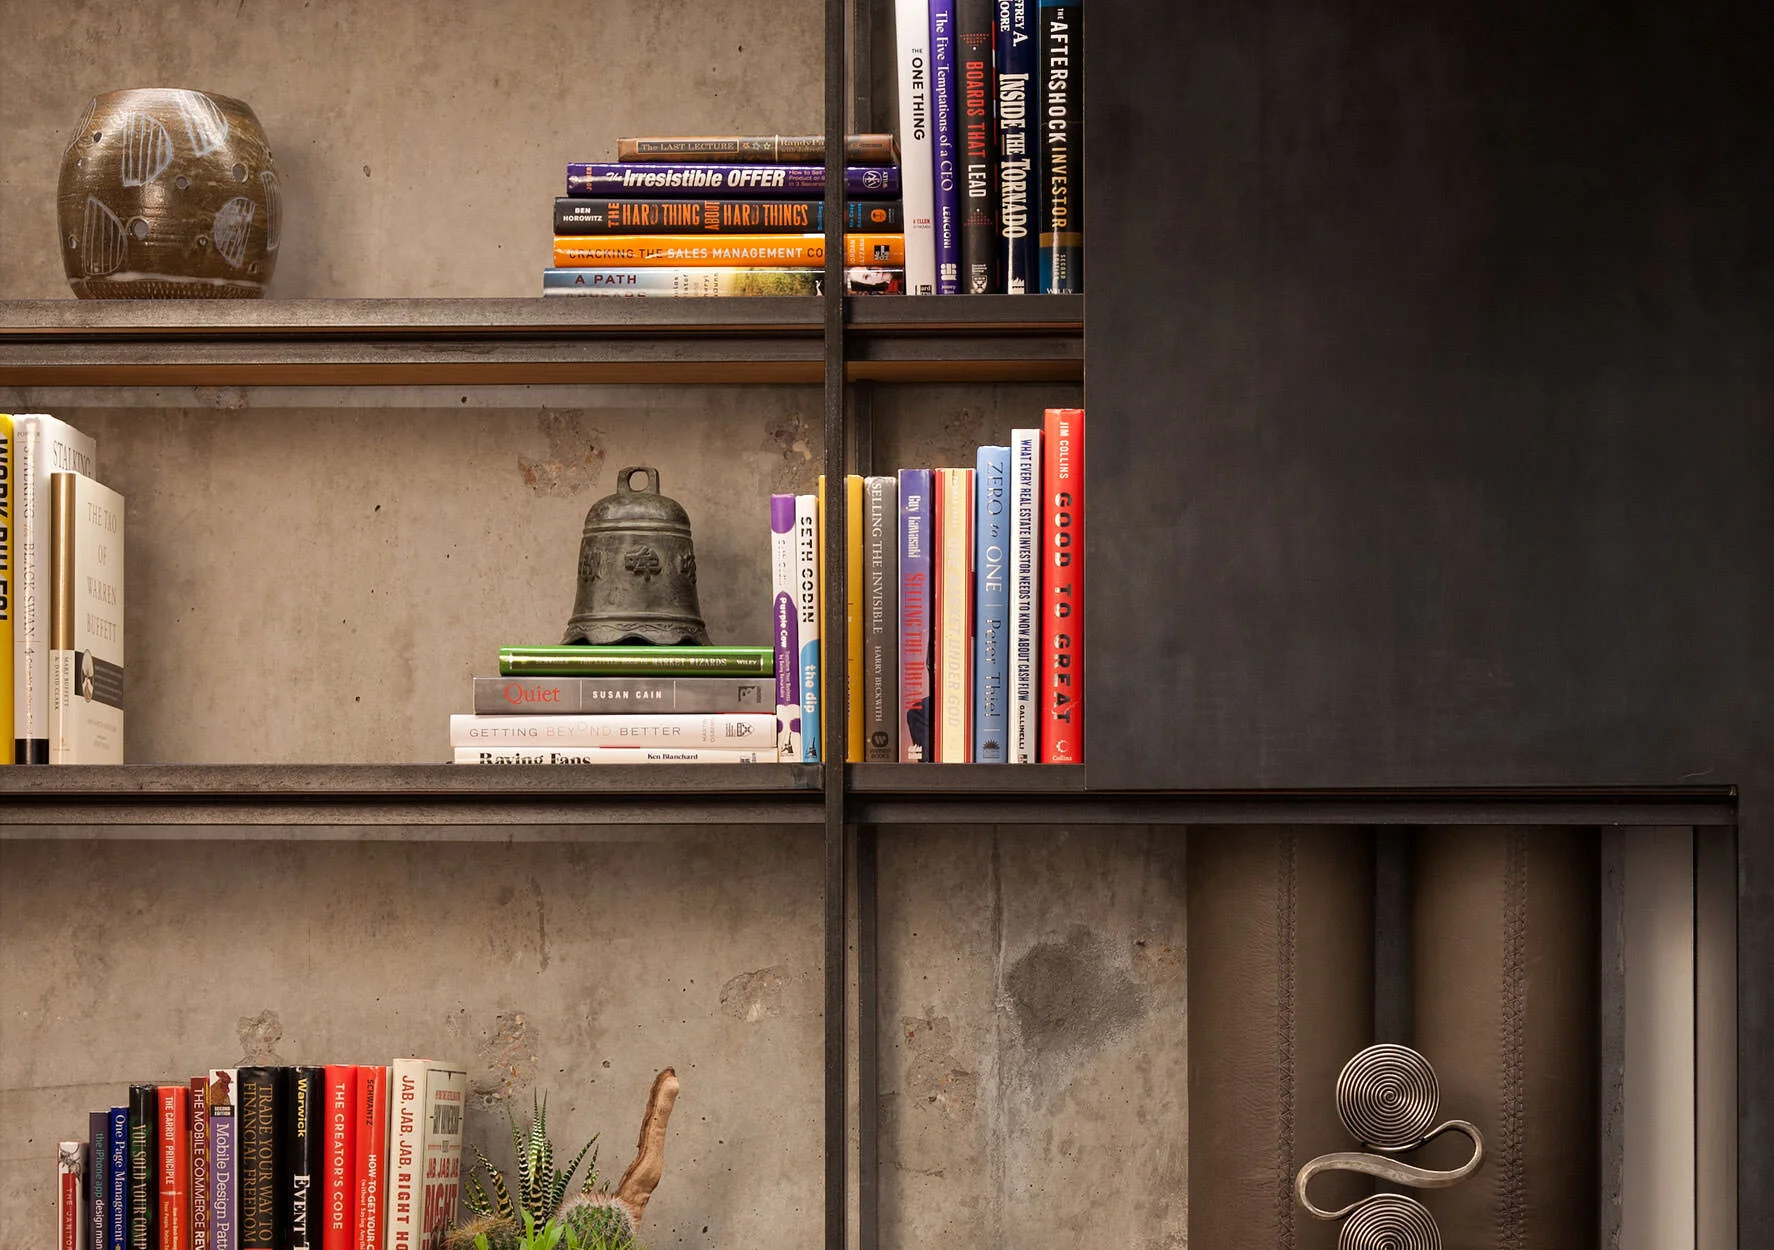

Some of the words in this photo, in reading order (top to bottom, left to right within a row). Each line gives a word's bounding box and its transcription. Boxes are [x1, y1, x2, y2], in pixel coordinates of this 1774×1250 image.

[912, 57, 924, 90] ONE
[966, 62, 984, 116] BOARDS
[1048, 22, 1068, 144] AFTERSHOCK
[913, 93, 925, 140] THING
[999, 73, 1029, 130] INSIDE
[968, 122, 986, 158] THAT
[1006, 132, 1026, 155] THE
[606, 172, 624, 182] The
[623, 170, 722, 187] Irresistible
[727, 170, 786, 187] OFFER
[968, 164, 987, 197] LEAD
[1052, 147, 1068, 228] INVESTOR
[608, 202, 620, 228] THE
[622, 204, 658, 225] HARD
[662, 204, 700, 225] THING
[704, 200, 720, 230] ABOUT
[723, 204, 760, 226] HARD
[762, 204, 809, 226] THINGS
[1000, 158, 1031, 238] TORNADO
[942, 206, 951, 248] LENCIONI
[569, 248, 634, 259] CRACKING
[639, 248, 663, 259] THE
[668, 248, 708, 258] SALES
[712, 248, 803, 258] MANAGEMENT
[575, 274, 585, 284] A
[594, 274, 637, 284] PATH
[1060, 422, 1069, 437] JIM
[1060, 440, 1069, 479] COLLINS
[986, 462, 1003, 516] ZERO
[872, 482, 882, 537] SELLING
[1054, 492, 1072, 567] GOOD
[872, 540, 882, 568] THE
[986, 545, 1002, 592] ONE
[873, 572, 883, 634] INVISIBLE
[1054, 584, 1072, 618] TO
[504, 682, 560, 704] Quiet
[804, 664, 816, 688] the
[1052, 634, 1071, 724] GREAT
[592, 691, 629, 699] SUSAN
[635, 691, 662, 699] CAIN
[804, 692, 816, 713] dip
[469, 728, 538, 737] GETTING
[546, 721, 612, 737] BEYOND
[620, 727, 681, 736] BETTER
[165, 1097, 174, 1109] THE
[194, 1088, 204, 1110] THE
[335, 1083, 345, 1109] THE
[366, 1079, 374, 1126] SCHWANTZ
[402, 1076, 414, 1104] JAB,
[242, 1082, 257, 1165] FINANCIAL
[258, 1084, 273, 1135] TRADE
[297, 1078, 307, 1138] Warwick
[400, 1108, 414, 1136] JAB,
[115, 1114, 126, 1138] One
[132, 1124, 147, 1150] YOU
[165, 1111, 174, 1142] CARROT
[194, 1112, 205, 1154] MOBILE
[113, 1140, 127, 1168] Page
[216, 1123, 230, 1170] Mobile
[258, 1139, 273, 1182] YOUR
[334, 1114, 345, 1187] CREATOR'S
[398, 1140, 412, 1169] JAB,
[132, 1152, 147, 1180] SOLD
[165, 1147, 174, 1185] PRINCIPLE
[368, 1154, 376, 1178] HOW
[132, 1181, 147, 1218] YOUR
[194, 1156, 205, 1226] COMMERCE
[214, 1172, 230, 1220] Design
[258, 1187, 273, 1217] WAY
[368, 1180, 376, 1193] TO
[397, 1173, 411, 1224] RIGHT
[113, 1171, 127, 1242] Management
[243, 1169, 257, 1242] FREEDOM
[293, 1174, 310, 1236] EVENT
[332, 1191, 344, 1230] CODE
[367, 1195, 376, 1214] GET
[258, 1219, 273, 1241] TO
[366, 1216, 375, 1242] YOUR
